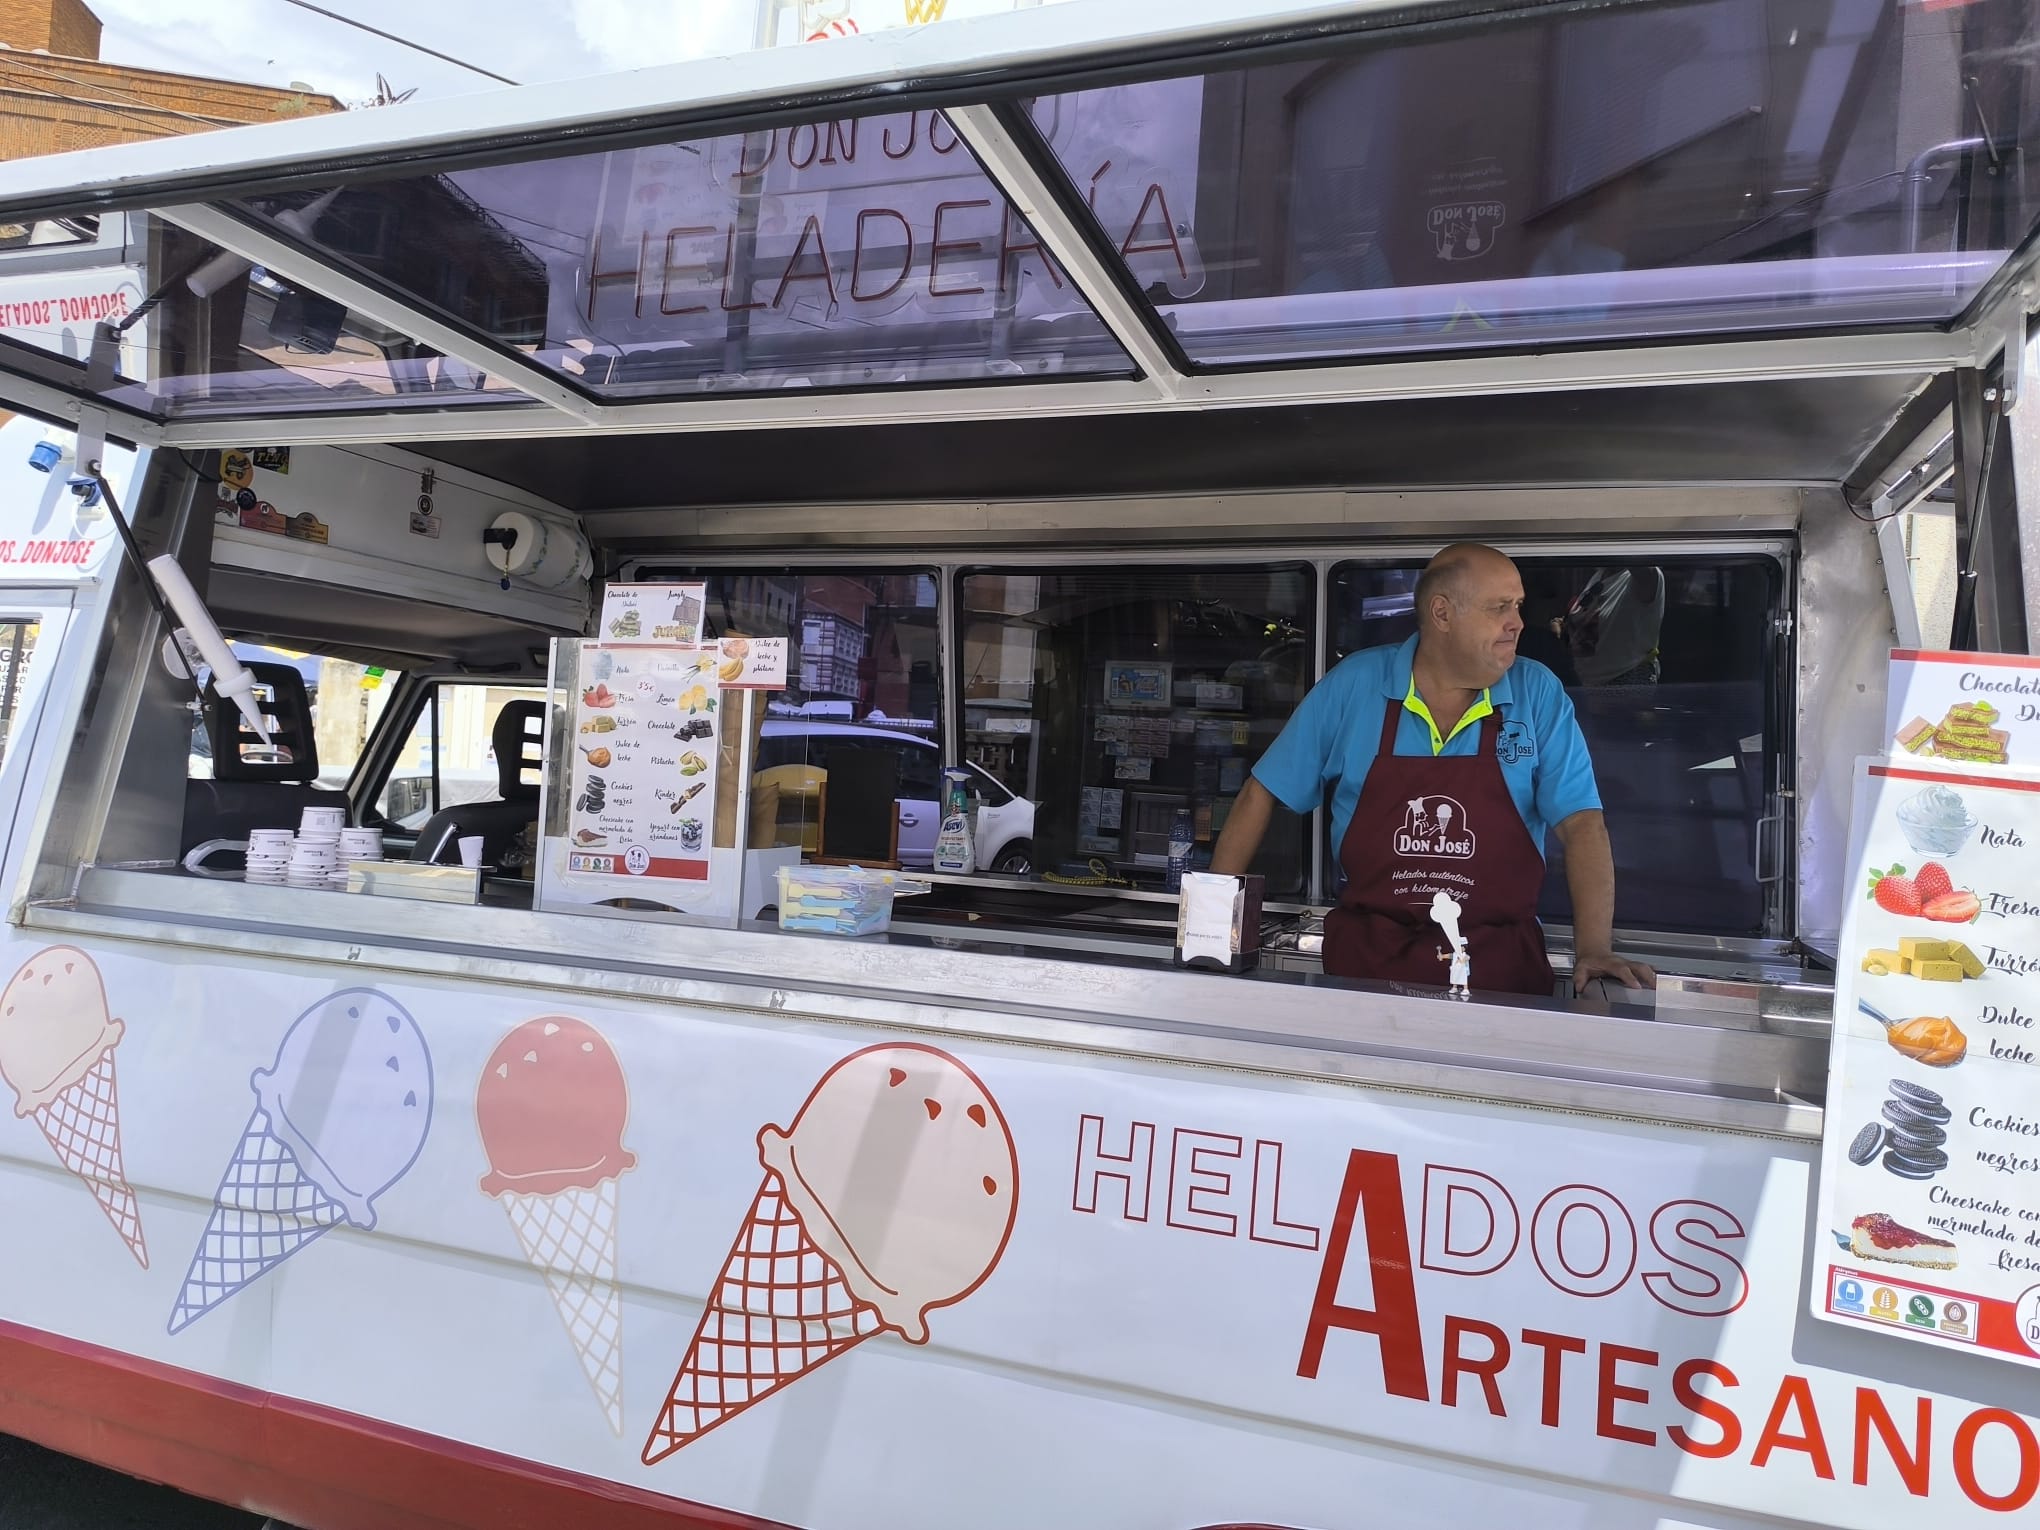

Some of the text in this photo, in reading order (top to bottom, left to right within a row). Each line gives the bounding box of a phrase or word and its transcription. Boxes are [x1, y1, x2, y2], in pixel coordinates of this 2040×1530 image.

[647, 719, 676, 730] Chocolate
[611, 781, 633, 791] Cookies
[1980, 824, 2026, 849] Nata
[1392, 869, 1476, 886] Helados auténticos
[1394, 887, 1409, 896] con
[1977, 1005, 2036, 1029] Dulce
[1989, 1038, 2036, 1064] leche
[1968, 1106, 2040, 1137] Cookies
[1976, 1149, 2040, 1175] negros
[1928, 1185, 2012, 1217] Cheescake
[1927, 1213, 2017, 1244] mermelada
[1071, 1113, 1751, 1402] HELADOS
[1990, 1248, 2040, 1273] fresa
